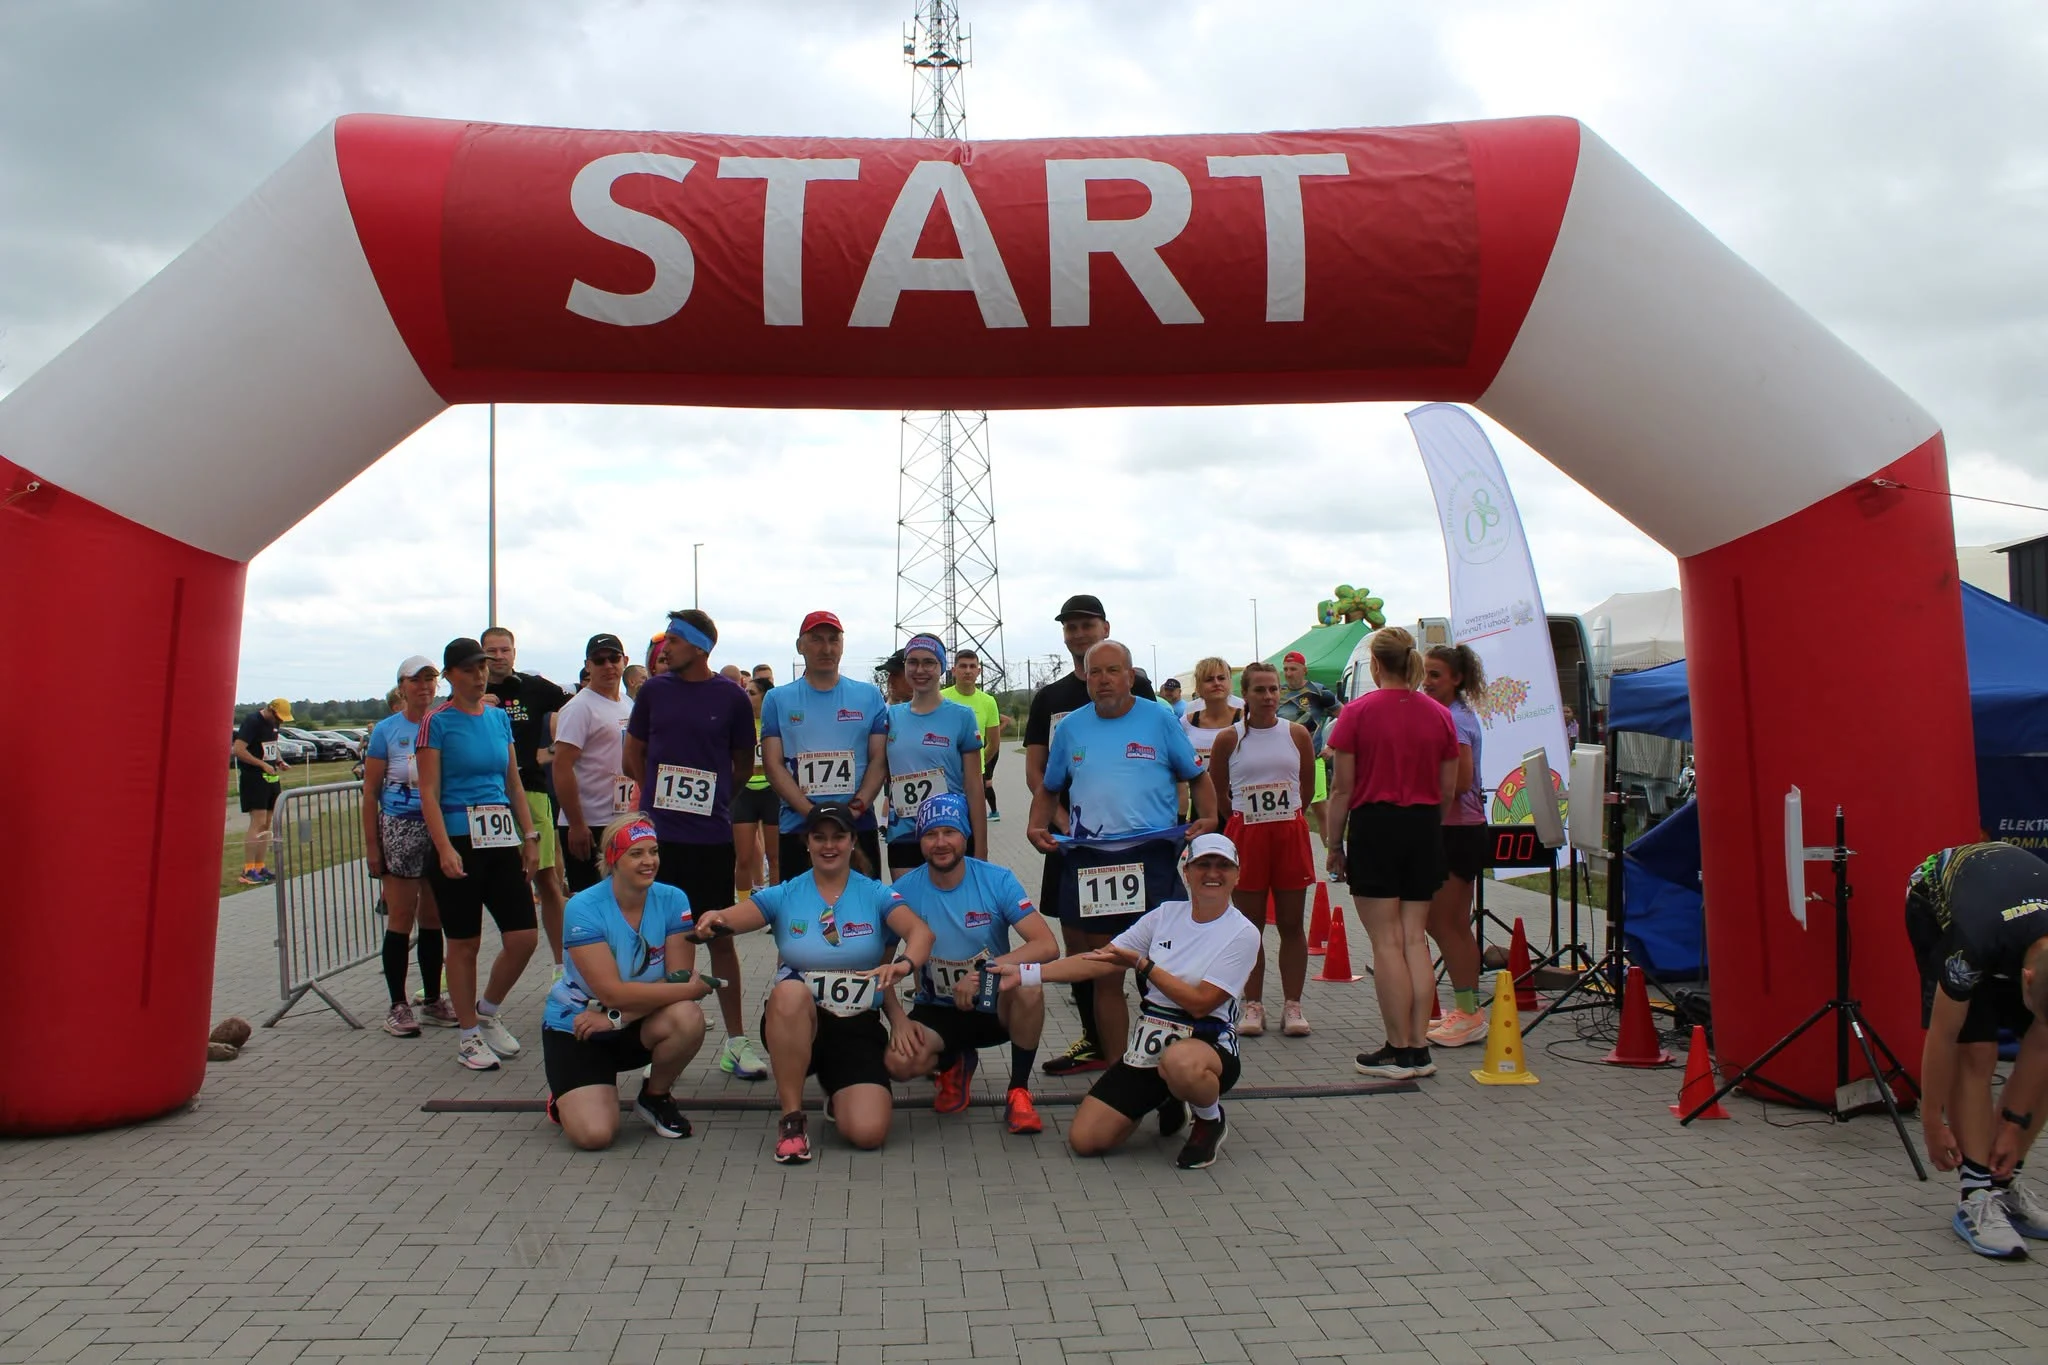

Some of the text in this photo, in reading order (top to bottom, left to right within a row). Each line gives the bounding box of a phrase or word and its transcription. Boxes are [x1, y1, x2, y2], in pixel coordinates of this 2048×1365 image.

[565, 152, 1350, 329] START
[804, 760, 851, 784] 174
[663, 775, 710, 802] 153
[903, 780, 932, 804] 82
[1248, 790, 1289, 812] 184
[476, 813, 512, 836] 190
[1086, 874, 1139, 902] 119
[813, 976, 870, 1003] 167
